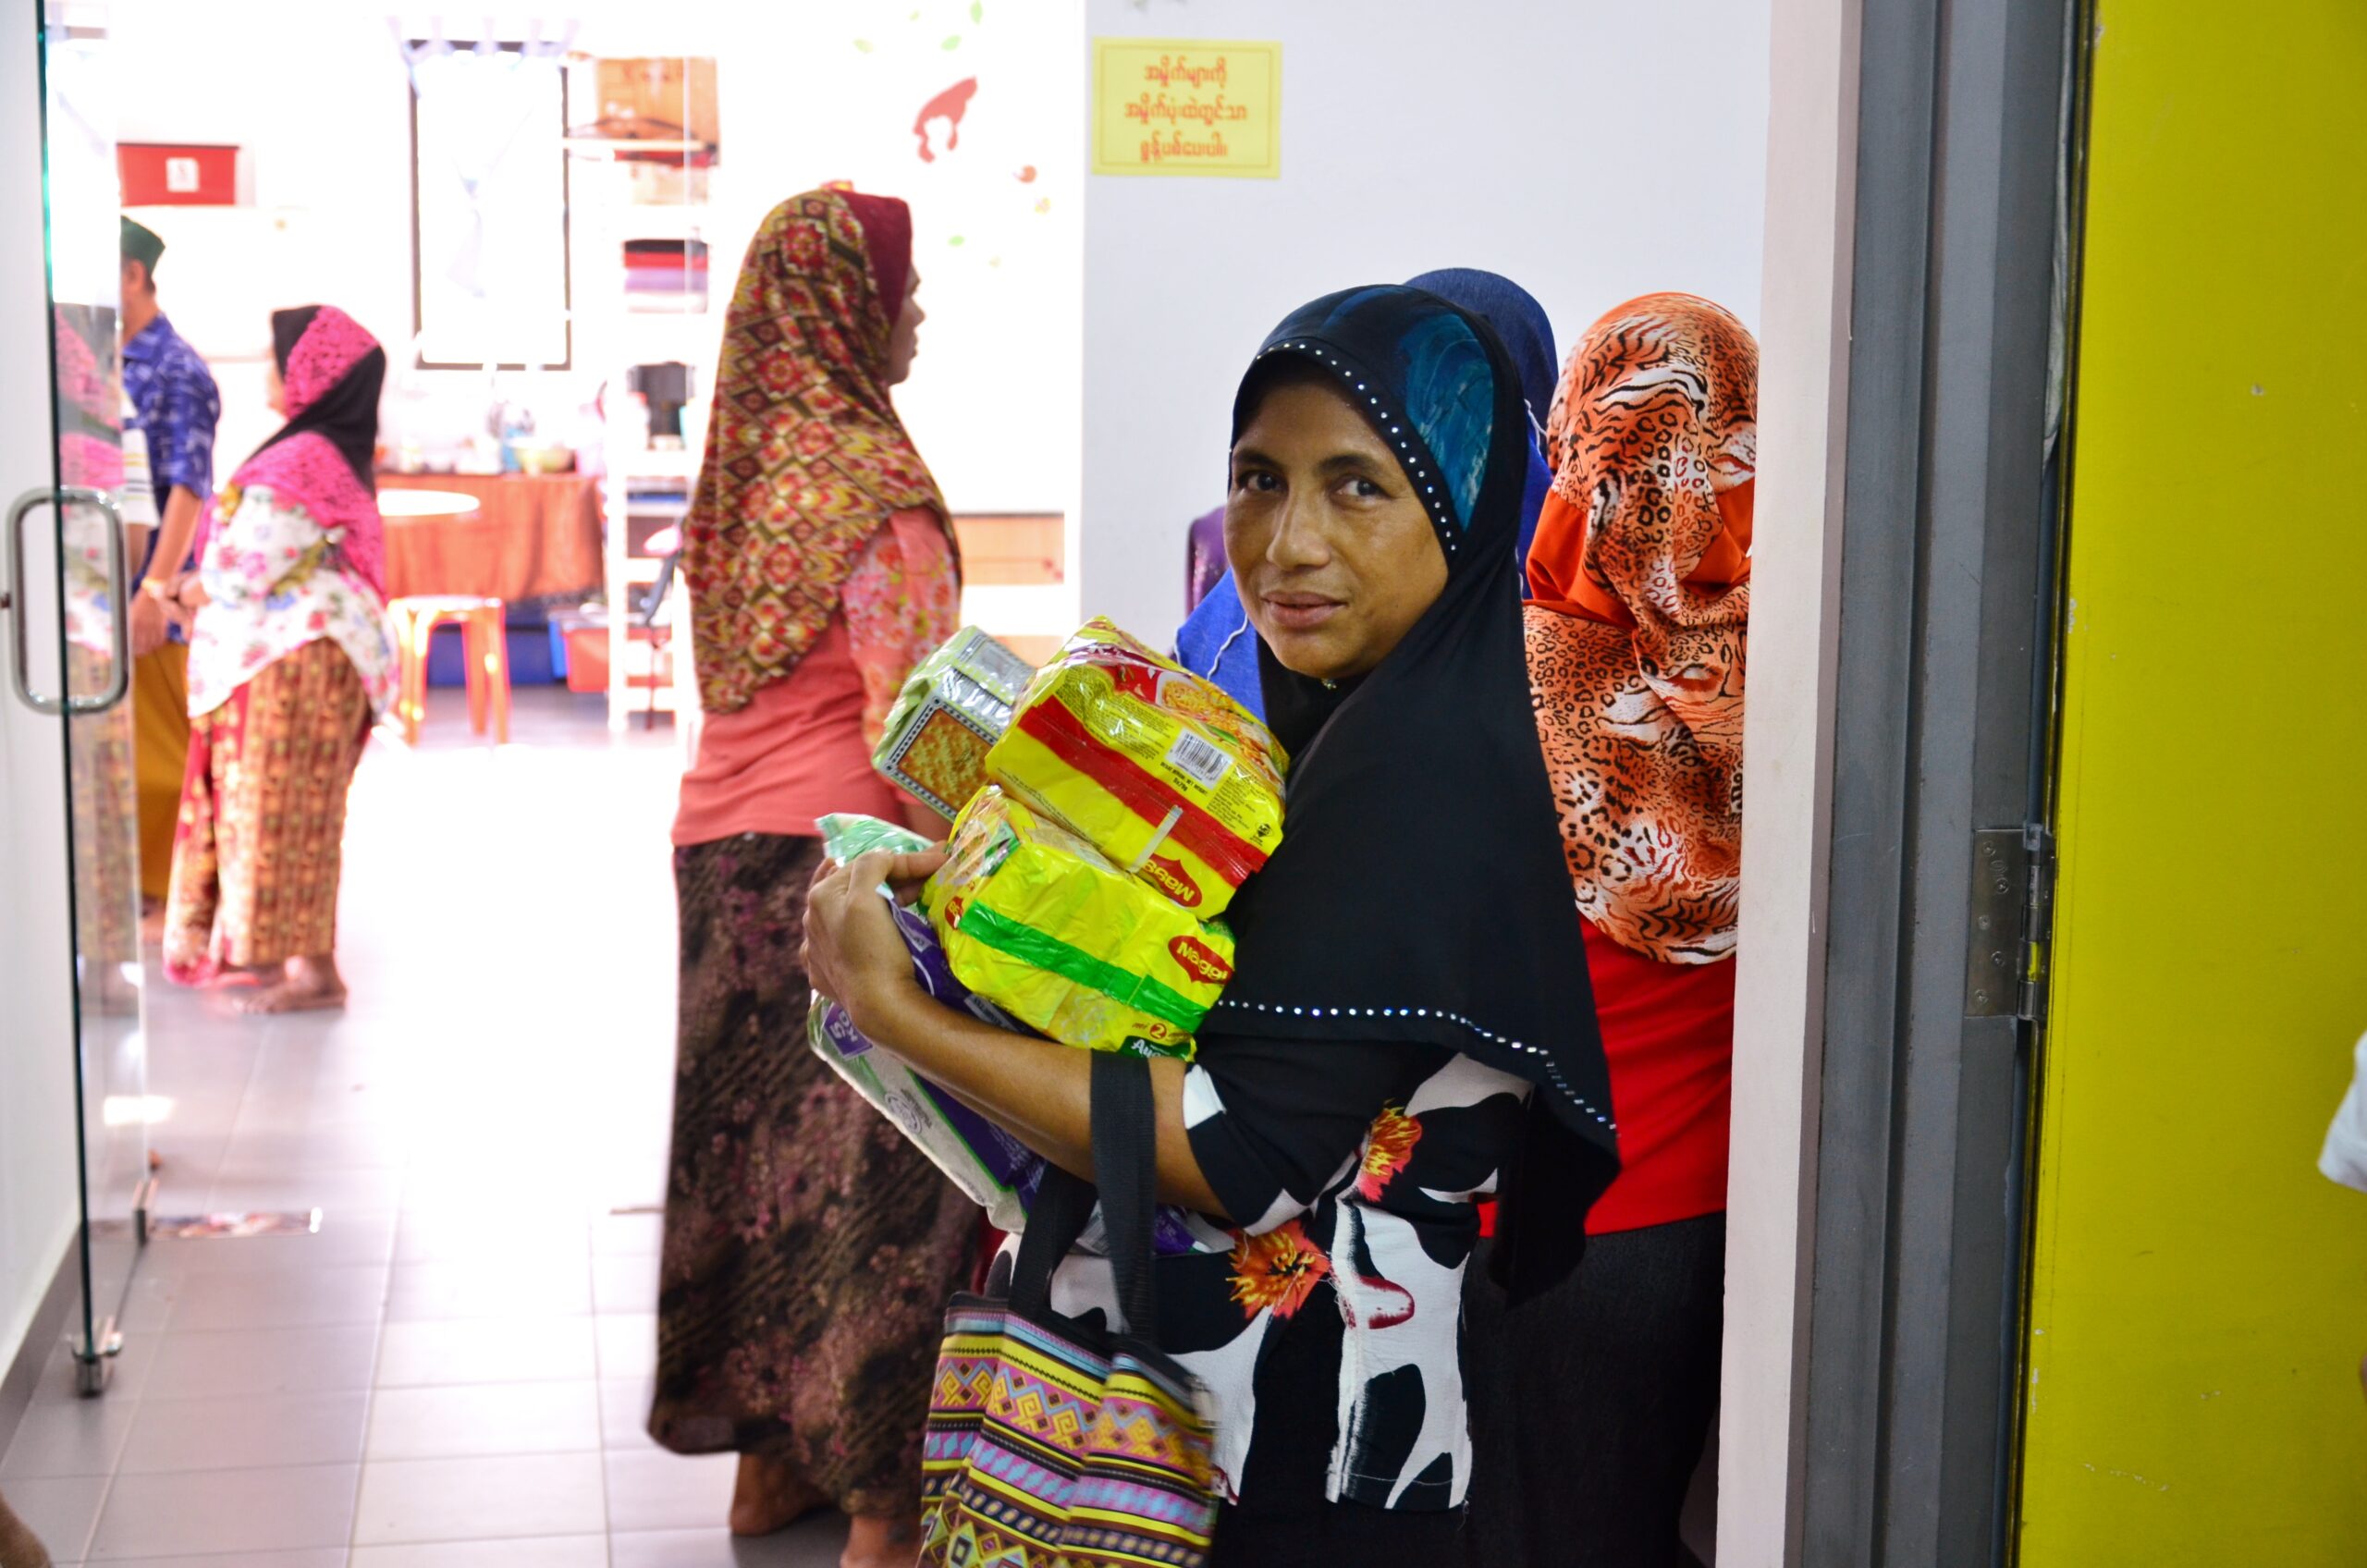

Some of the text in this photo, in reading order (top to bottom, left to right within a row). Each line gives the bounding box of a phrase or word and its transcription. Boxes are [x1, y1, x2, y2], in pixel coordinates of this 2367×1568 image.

[1143, 859, 1195, 902] Magg
[1176, 941, 1228, 981] Maggi
[1150, 1023, 1166, 1038] 2
